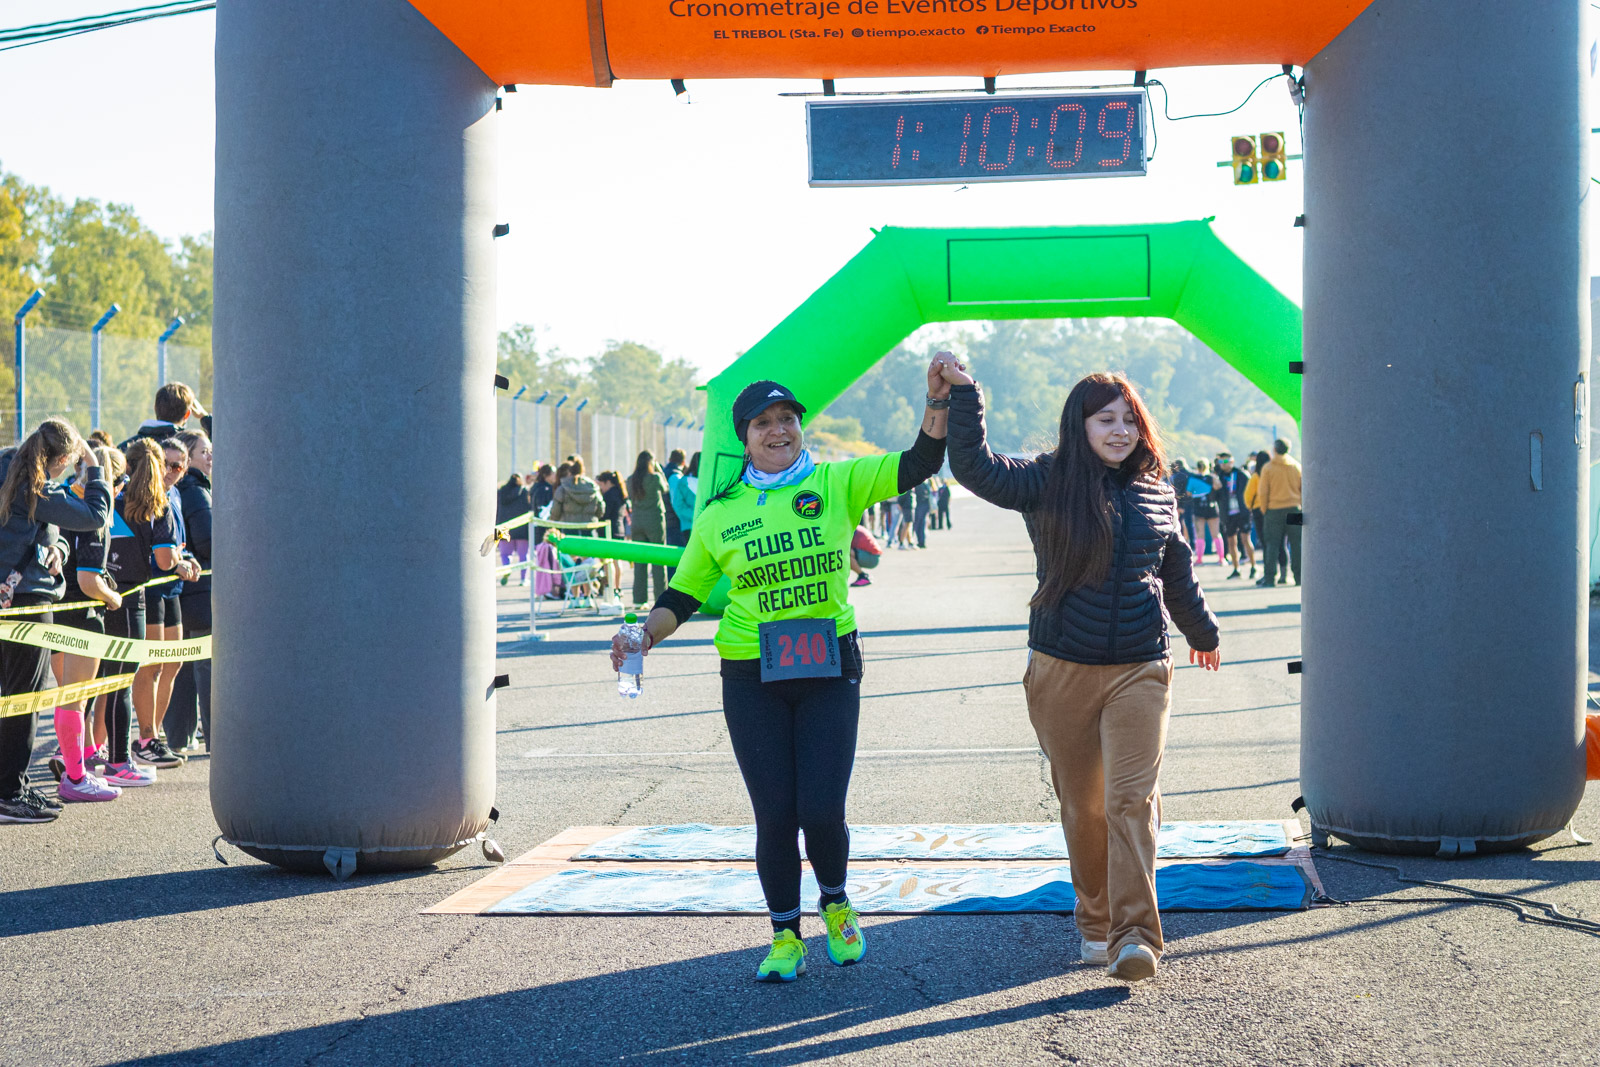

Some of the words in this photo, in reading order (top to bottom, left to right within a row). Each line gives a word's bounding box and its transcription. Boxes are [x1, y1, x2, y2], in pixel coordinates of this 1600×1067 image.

[669, 0, 840, 20] Cronometraje
[848, 0, 879, 15] de
[887, 0, 987, 14] Eventos
[996, 0, 1138, 16] Deportivos
[713, 30, 730, 39] EL
[732, 29, 786, 39] TREBOL
[789, 28, 821, 40] (Sta.
[823, 28, 844, 39] Fe)
[866, 26, 966, 39] tiempo.exacto
[991, 25, 1046, 36] Tiempo
[1049, 23, 1096, 34] Exacto
[720, 517, 763, 539] EMAPUR
[744, 531, 795, 562] CLUB
[798, 526, 825, 549] DE
[758, 580, 829, 613] RECREO
[42, 631, 90, 650] PRECAUCION
[763, 632, 774, 670] TIEMPO
[777, 632, 827, 667] 240
[826, 629, 837, 666] EXACTO
[148, 645, 202, 658] PRECAUCION
